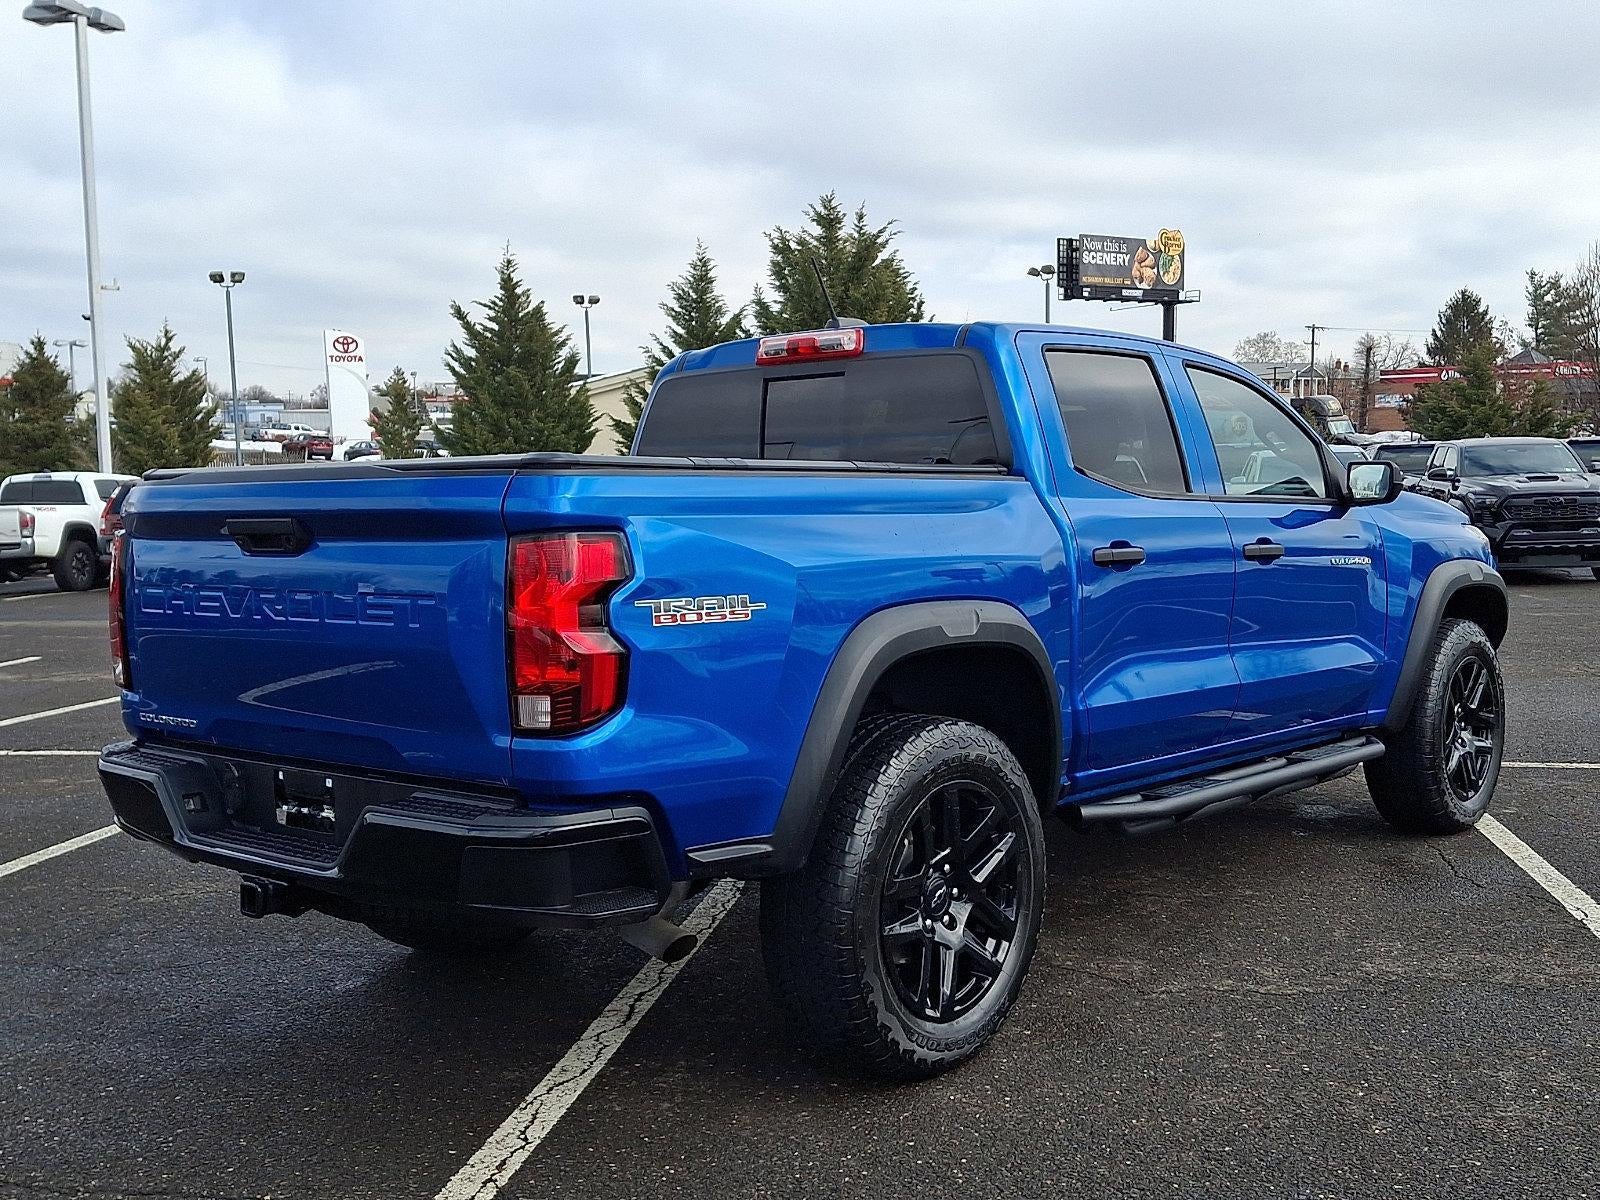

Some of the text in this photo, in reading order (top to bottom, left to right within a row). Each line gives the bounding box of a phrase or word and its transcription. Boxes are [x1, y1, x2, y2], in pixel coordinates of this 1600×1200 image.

[1083, 237, 1127, 252] Now this is
[1082, 250, 1130, 266] SCENERY
[141, 584, 437, 628] CHEVROLET
[635, 595, 766, 614] TRAIL
[653, 609, 751, 626] BOSS
[139, 712, 198, 728] COLORADO
